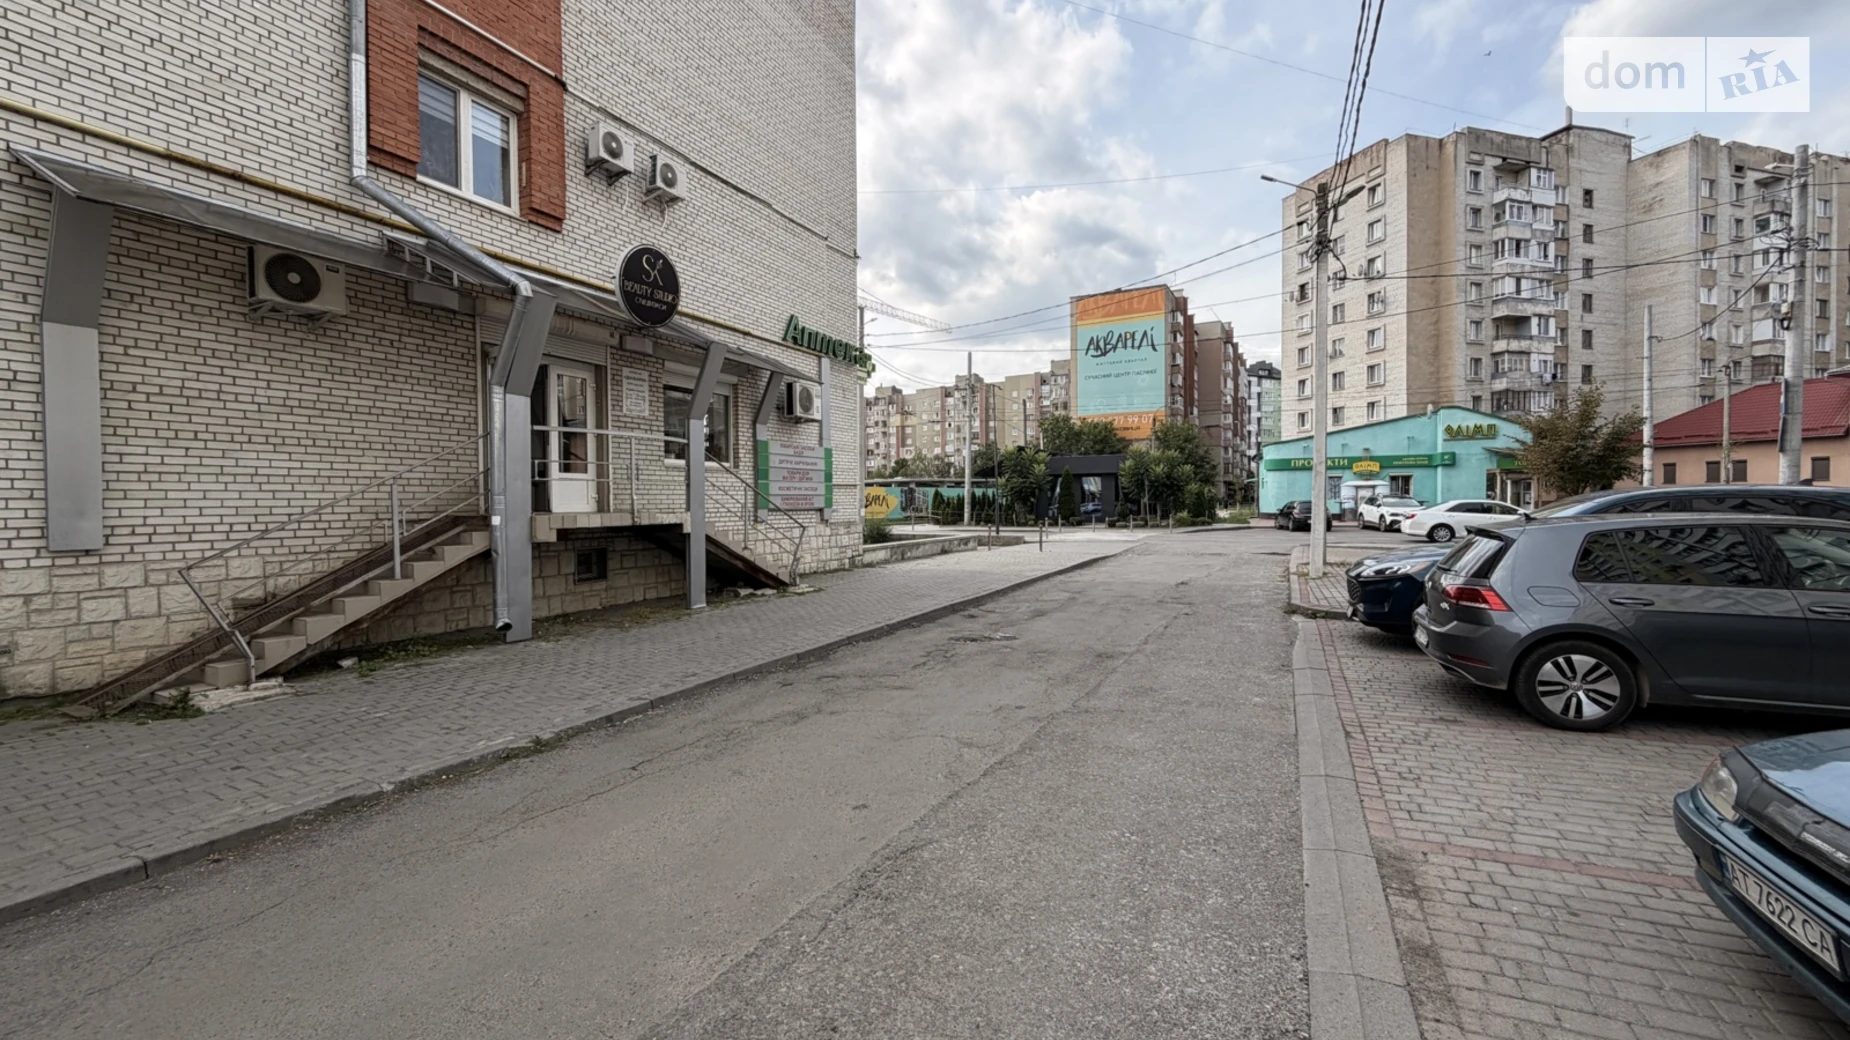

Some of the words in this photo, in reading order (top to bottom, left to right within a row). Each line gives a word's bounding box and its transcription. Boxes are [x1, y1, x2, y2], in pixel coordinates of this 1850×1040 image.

[623, 279, 652, 297] BEAUTY
[653, 288, 678, 304] STUDIO
[782, 314, 866, 365] Аптека
[1085, 326, 1158, 358] АКВАРЕЛІ
[1084, 372, 1112, 381] СУЧАСНИЙ
[1113, 370, 1131, 378] ЦЕНТР
[1127, 414, 1139, 424] 99
[1141, 413, 1154, 424] 07
[1444, 423, 1497, 437] ОЛІМП
[1291, 459, 1348, 467] ПРОКТИ
[865, 492, 890, 509] ВАРЕЛІ
[1731, 862, 1749, 896] AT
[1753, 880, 1798, 934] 7622
[1802, 918, 1834, 962] CA
